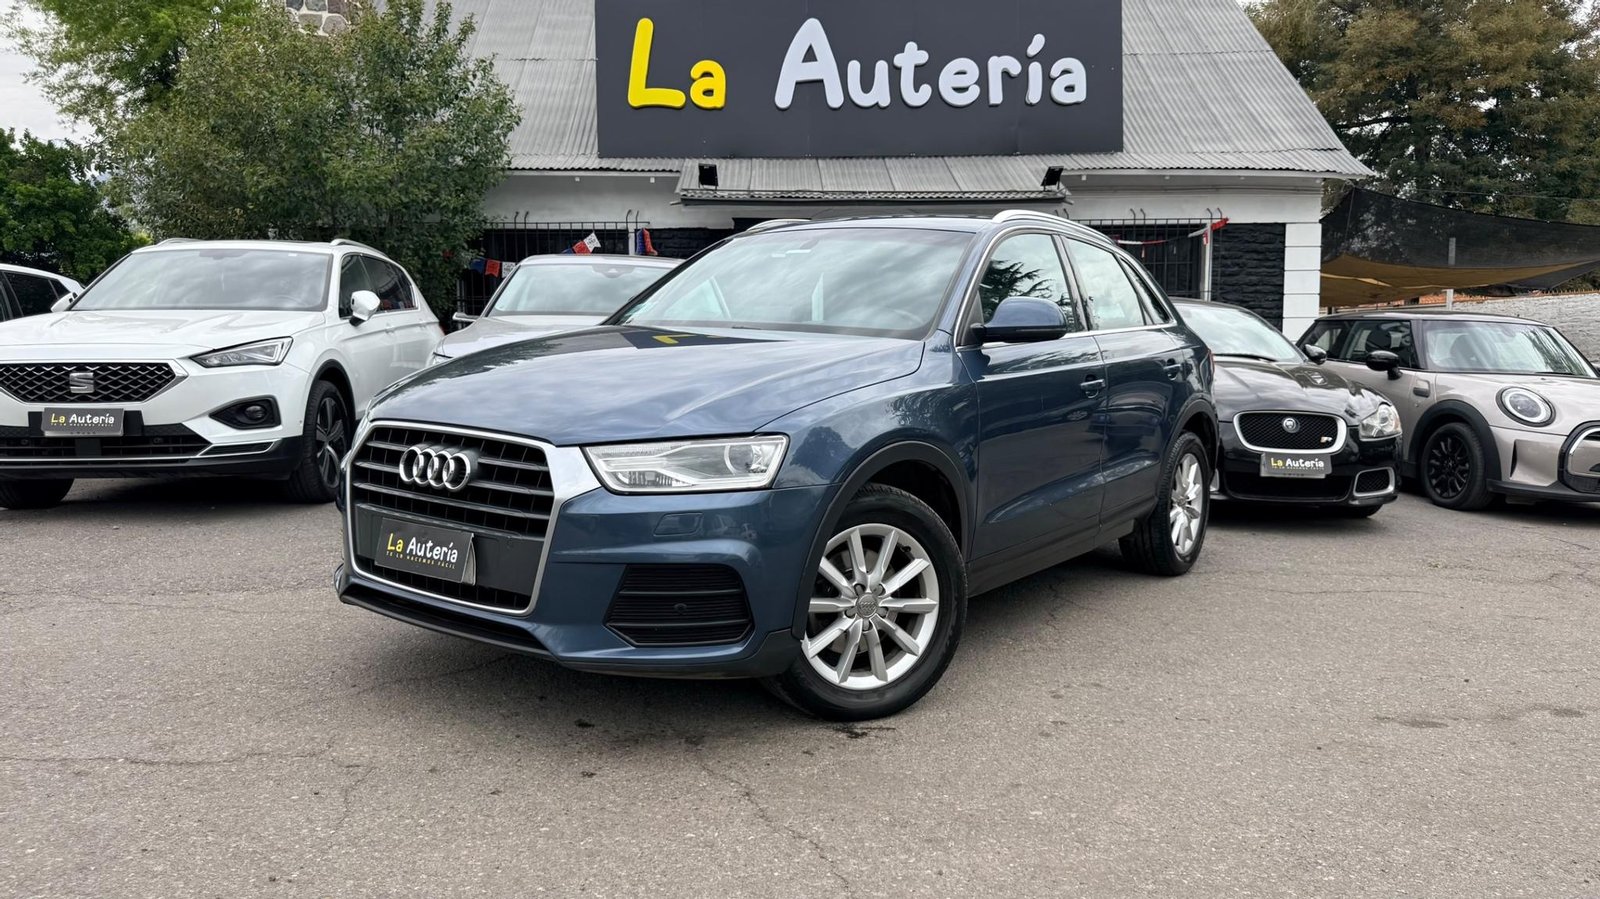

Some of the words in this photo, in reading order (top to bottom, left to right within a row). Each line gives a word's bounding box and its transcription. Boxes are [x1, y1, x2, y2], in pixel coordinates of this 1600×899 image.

[628, 17, 728, 110] La
[774, 17, 1089, 110] Autería
[51, 413, 66, 423] La
[69, 413, 115, 424] Autería
[1271, 457, 1283, 467] La
[1285, 457, 1324, 467] Autería
[387, 533, 404, 552] La
[406, 536, 458, 563] Autería
